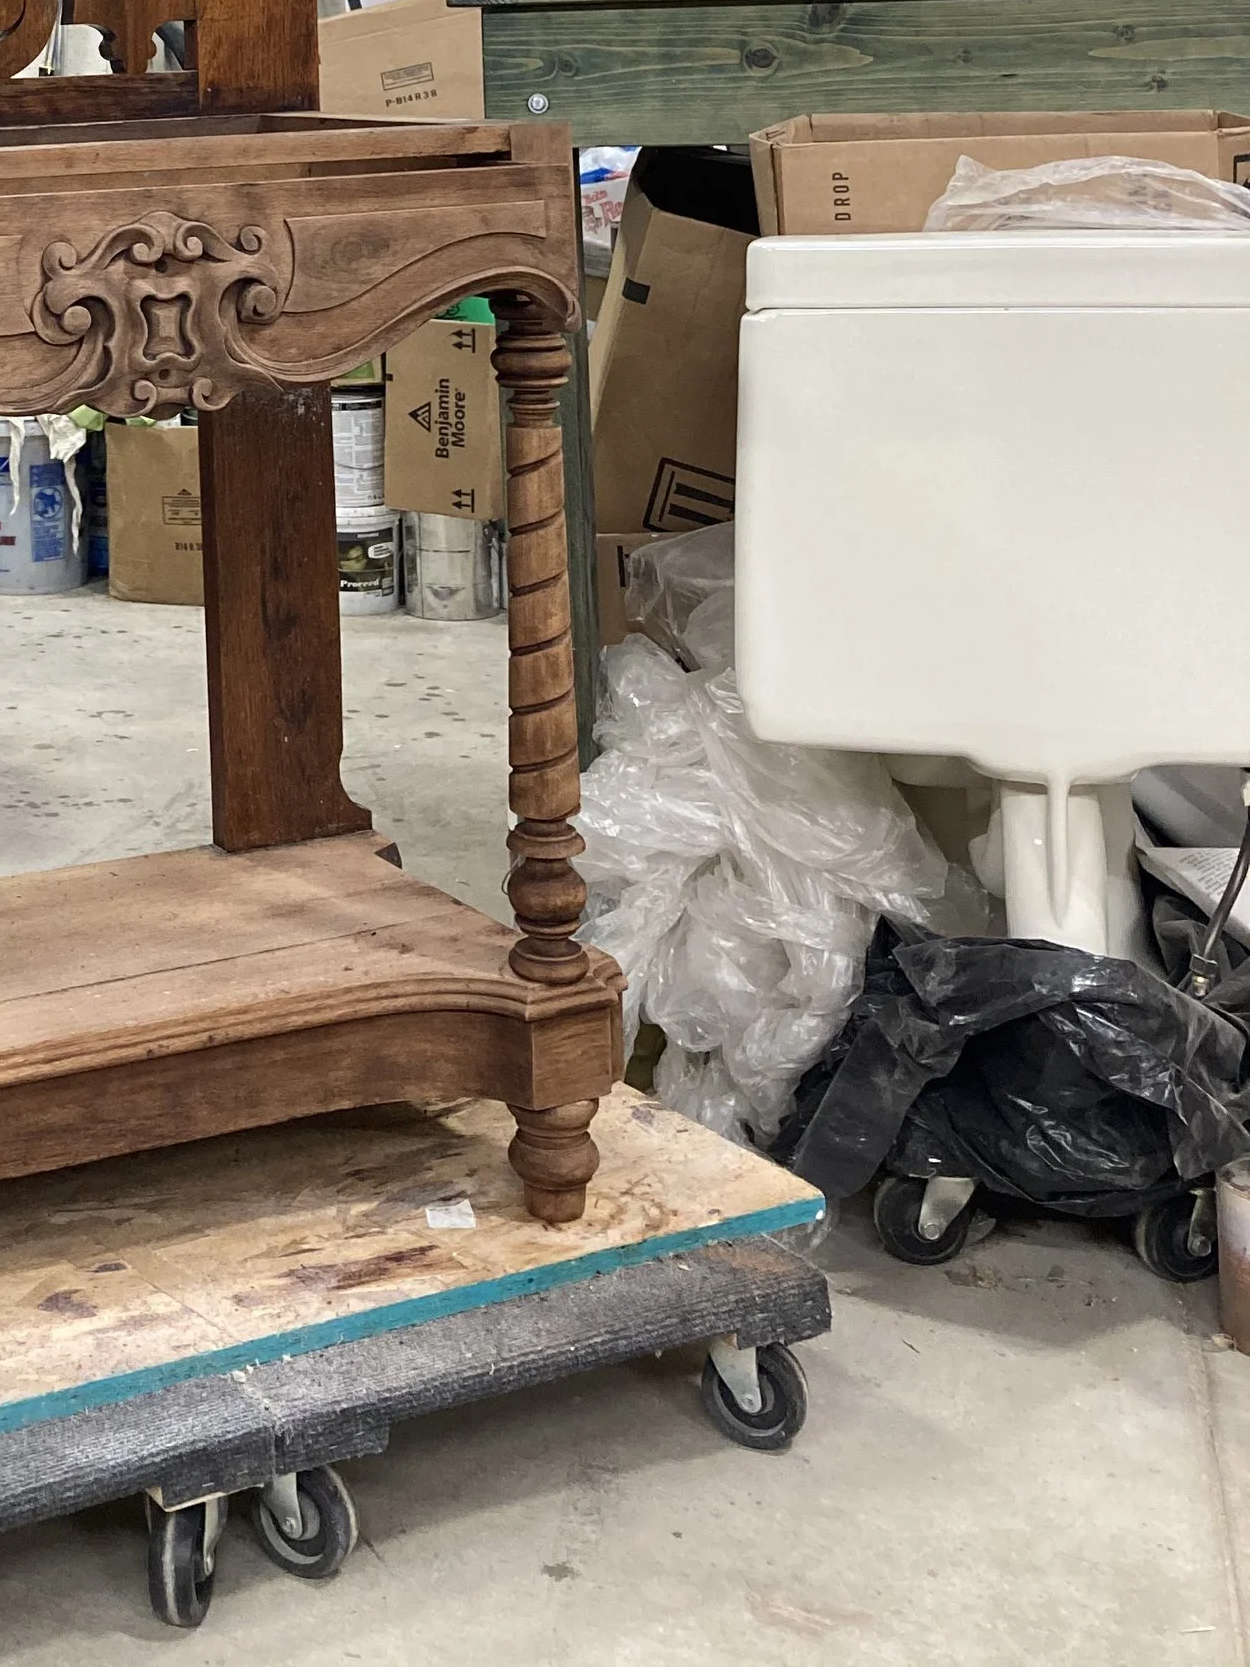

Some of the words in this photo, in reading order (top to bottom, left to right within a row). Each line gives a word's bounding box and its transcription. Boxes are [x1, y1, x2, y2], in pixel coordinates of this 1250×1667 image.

[832, 171, 850, 221] DROP
[435, 378, 453, 459] Benjamin
[451, 390, 466, 448] Moore
